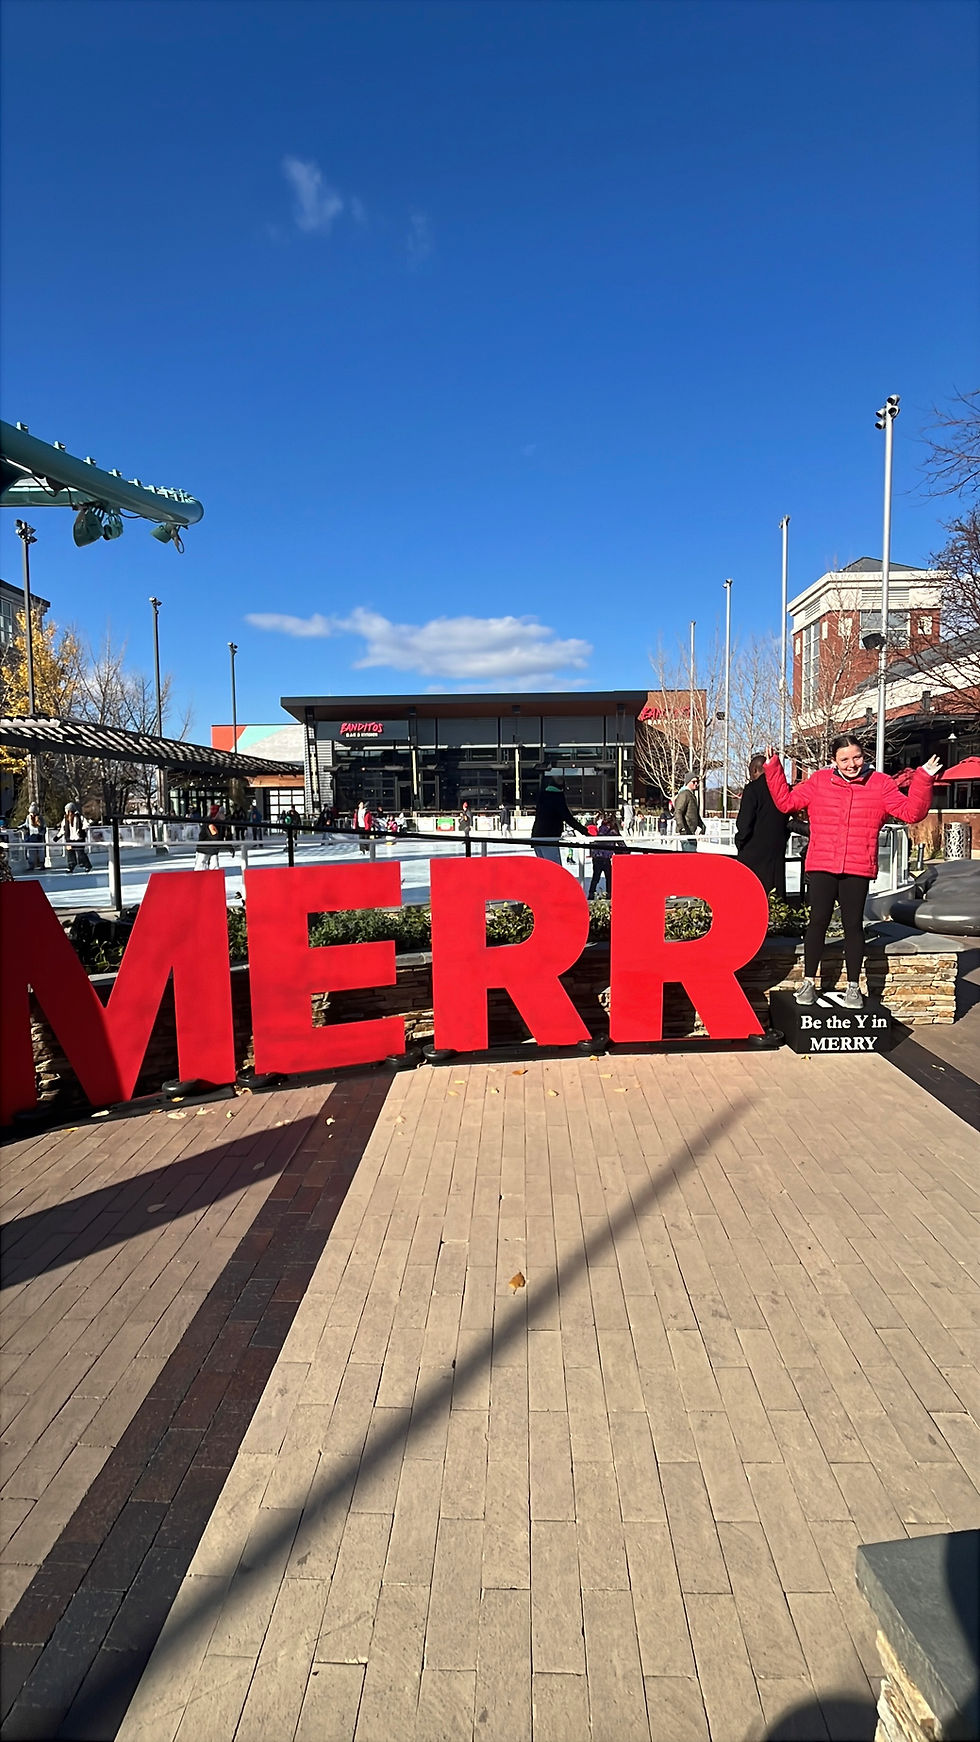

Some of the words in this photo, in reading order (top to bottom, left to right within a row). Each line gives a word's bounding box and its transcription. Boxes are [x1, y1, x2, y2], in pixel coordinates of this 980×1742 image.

[340, 722, 383, 734] BANDITOS
[0, 855, 769, 1120] MERR
[800, 1015, 822, 1029] Be
[825, 1015, 851, 1029] the
[854, 1015, 869, 1028] Y
[871, 1014, 888, 1028] in
[810, 1036, 878, 1051] MERRY
